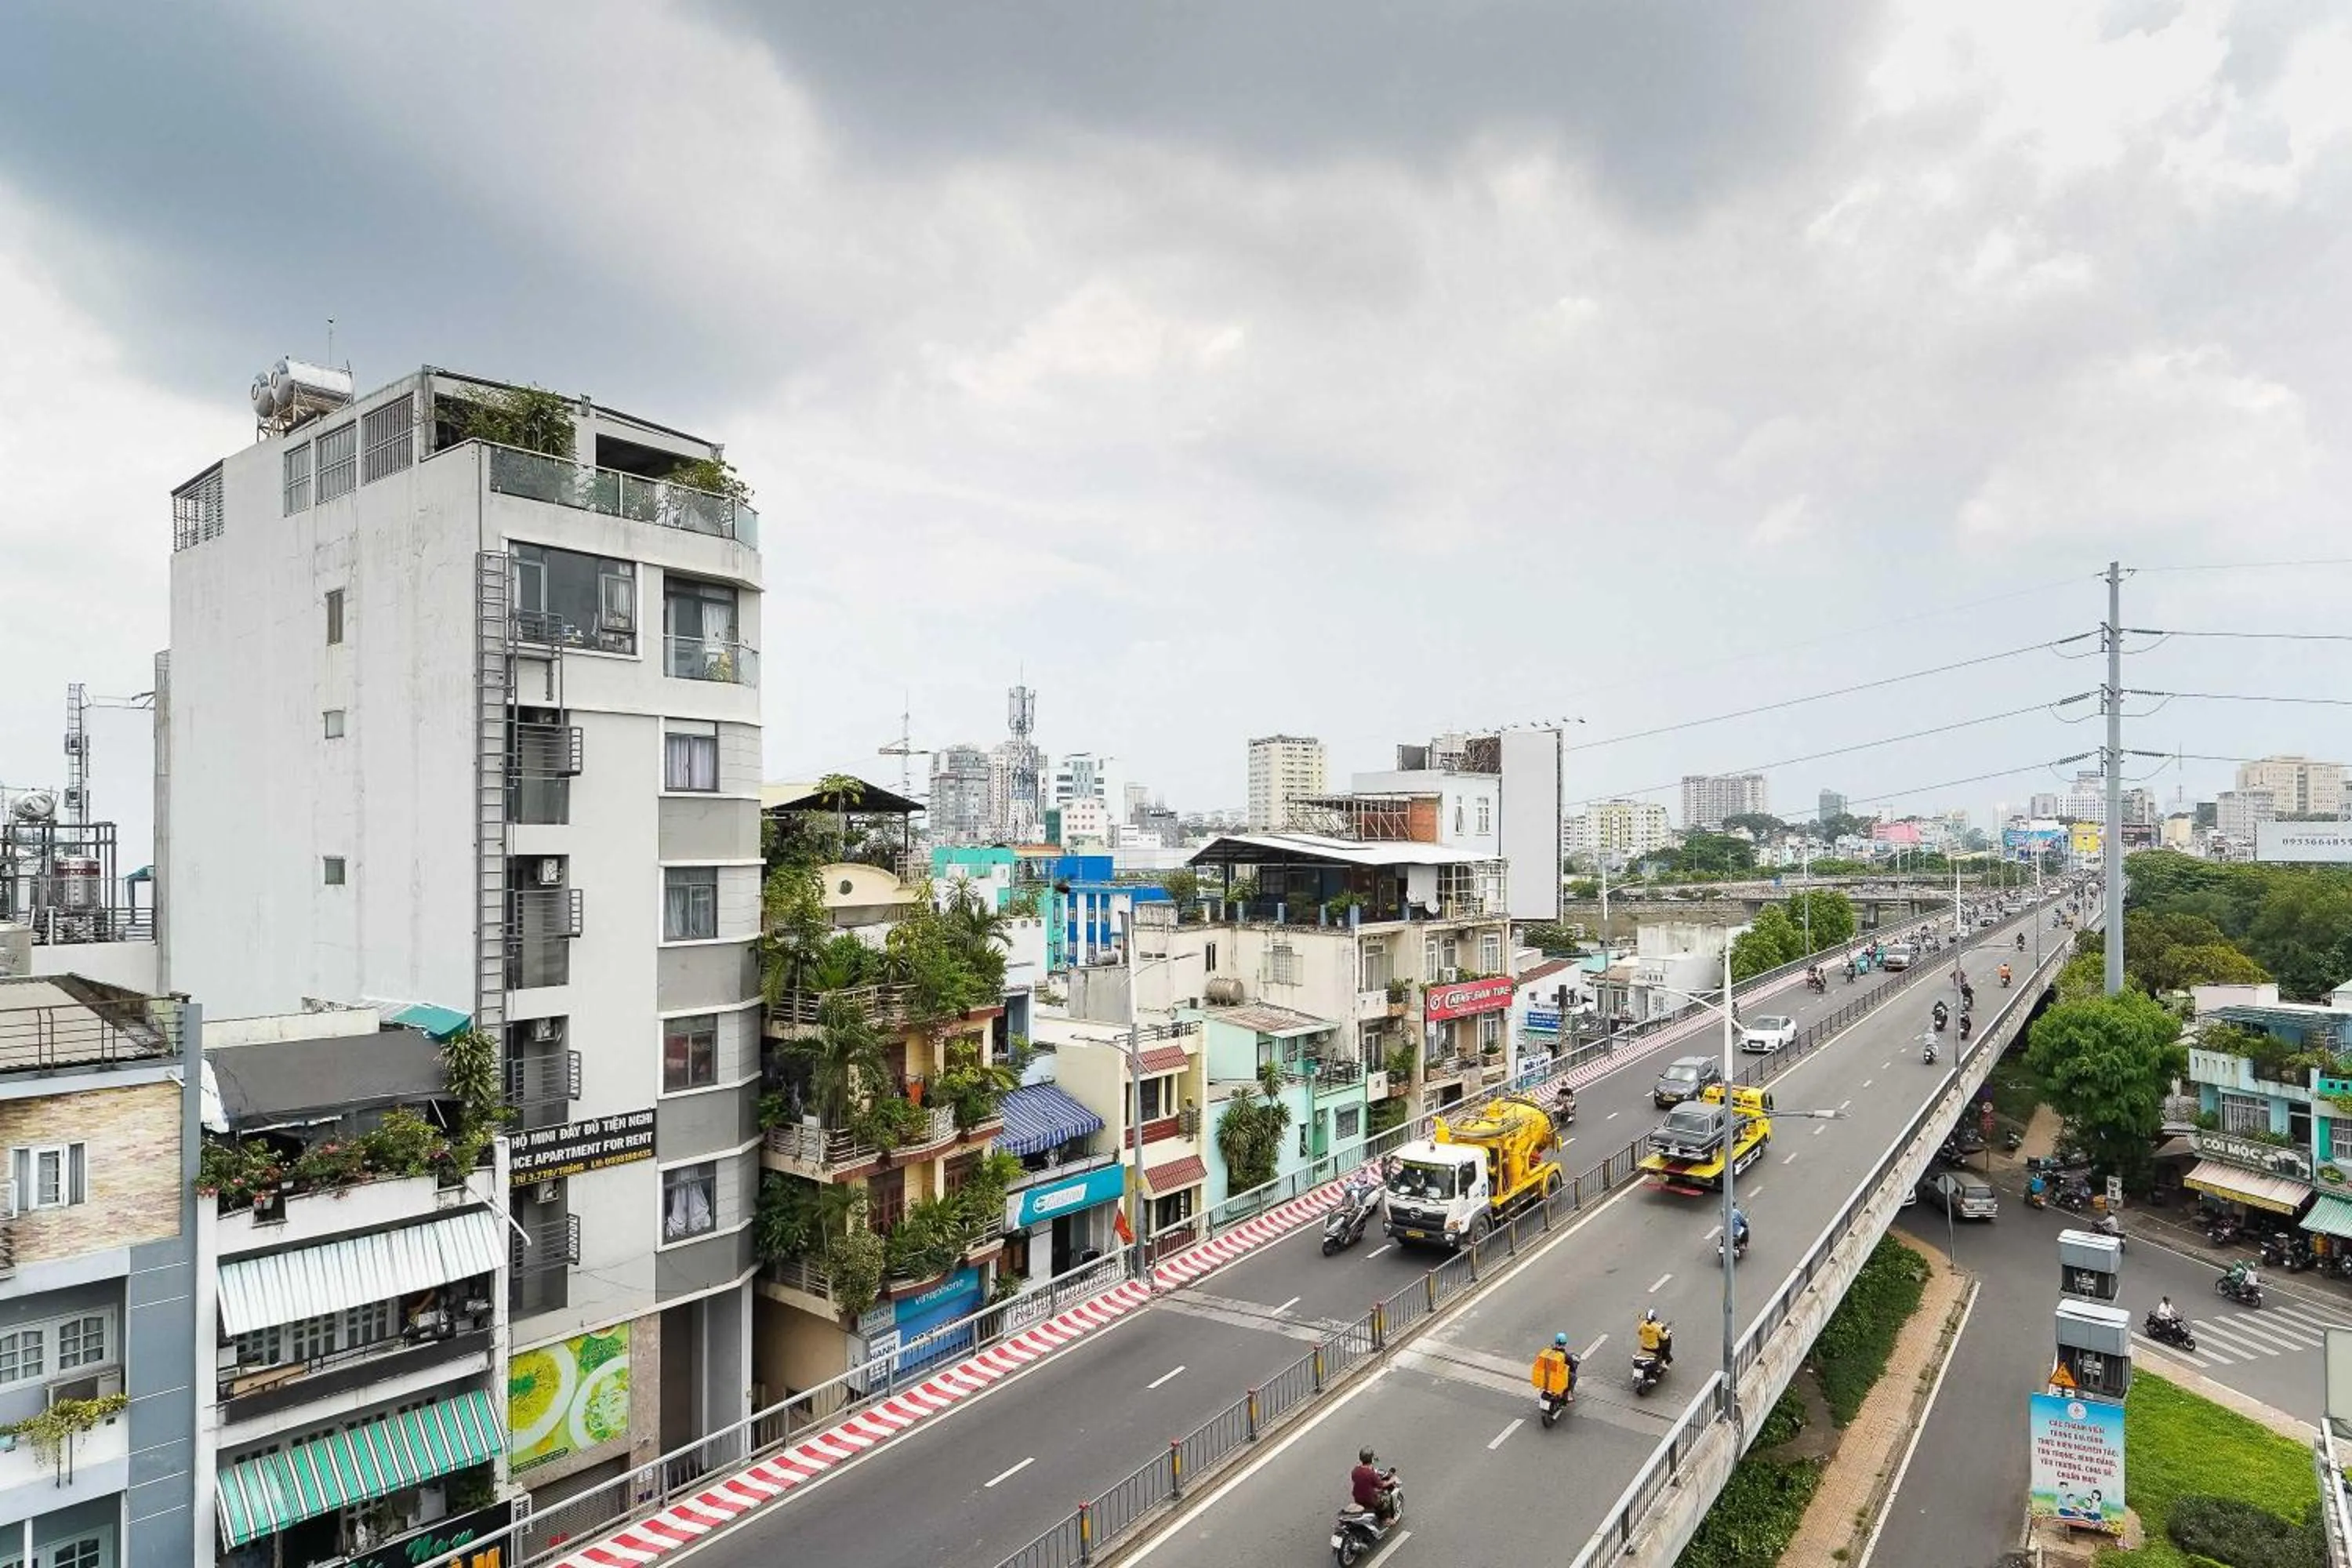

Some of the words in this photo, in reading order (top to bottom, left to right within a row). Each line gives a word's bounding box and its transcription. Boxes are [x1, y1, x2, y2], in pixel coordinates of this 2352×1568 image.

[531, 1130, 556, 1145] MINI
[628, 1112, 653, 1127] NGHI
[534, 1142, 601, 1166] APARTMENT
[603, 1138, 625, 1152] FOR
[626, 1131, 653, 1147] RENT
